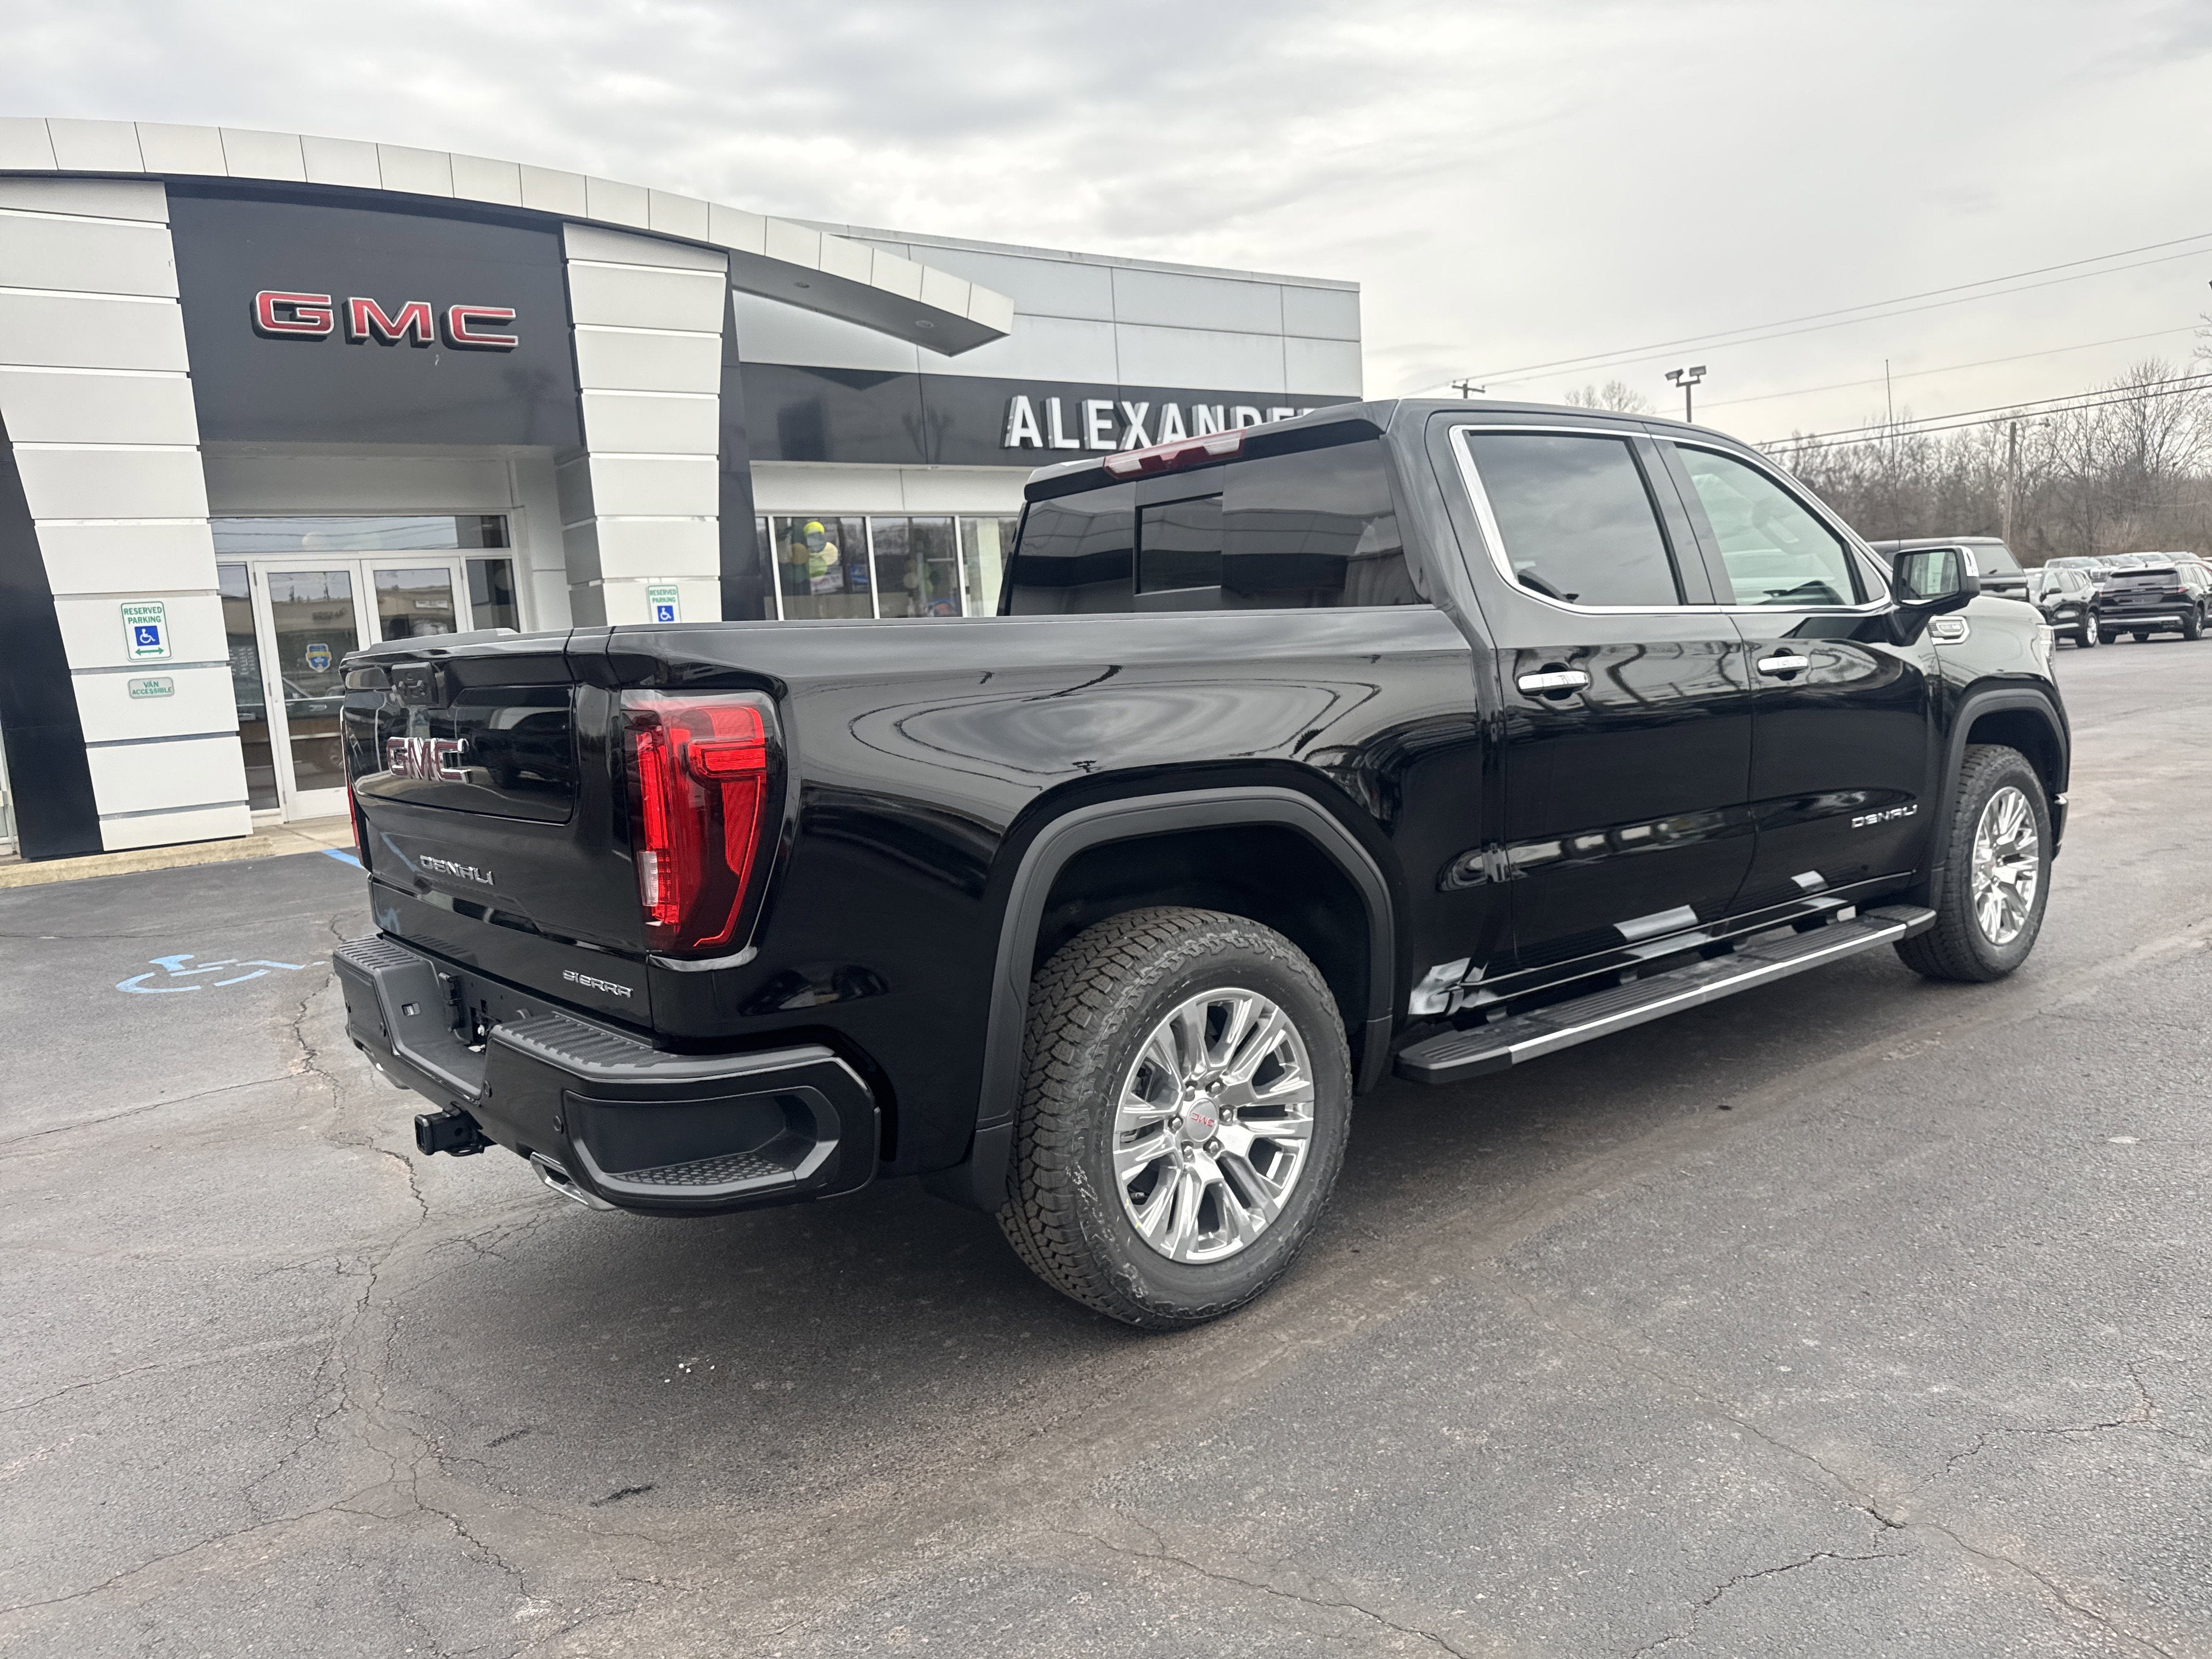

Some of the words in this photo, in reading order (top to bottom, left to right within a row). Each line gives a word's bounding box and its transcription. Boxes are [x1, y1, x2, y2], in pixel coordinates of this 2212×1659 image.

[250, 290, 519, 352] GMC
[1005, 395, 1317, 451] ALEXAN
[123, 607, 162, 616] RESERVED
[128, 616, 161, 624] PARKING
[132, 687, 172, 695] ACCESSIBLE
[386, 736, 473, 784] GMC
[1852, 804, 1918, 829] DENALI
[420, 855, 494, 885] DENALI
[562, 969, 634, 998] SIERRA
[1190, 1112, 1215, 1127] GMC
